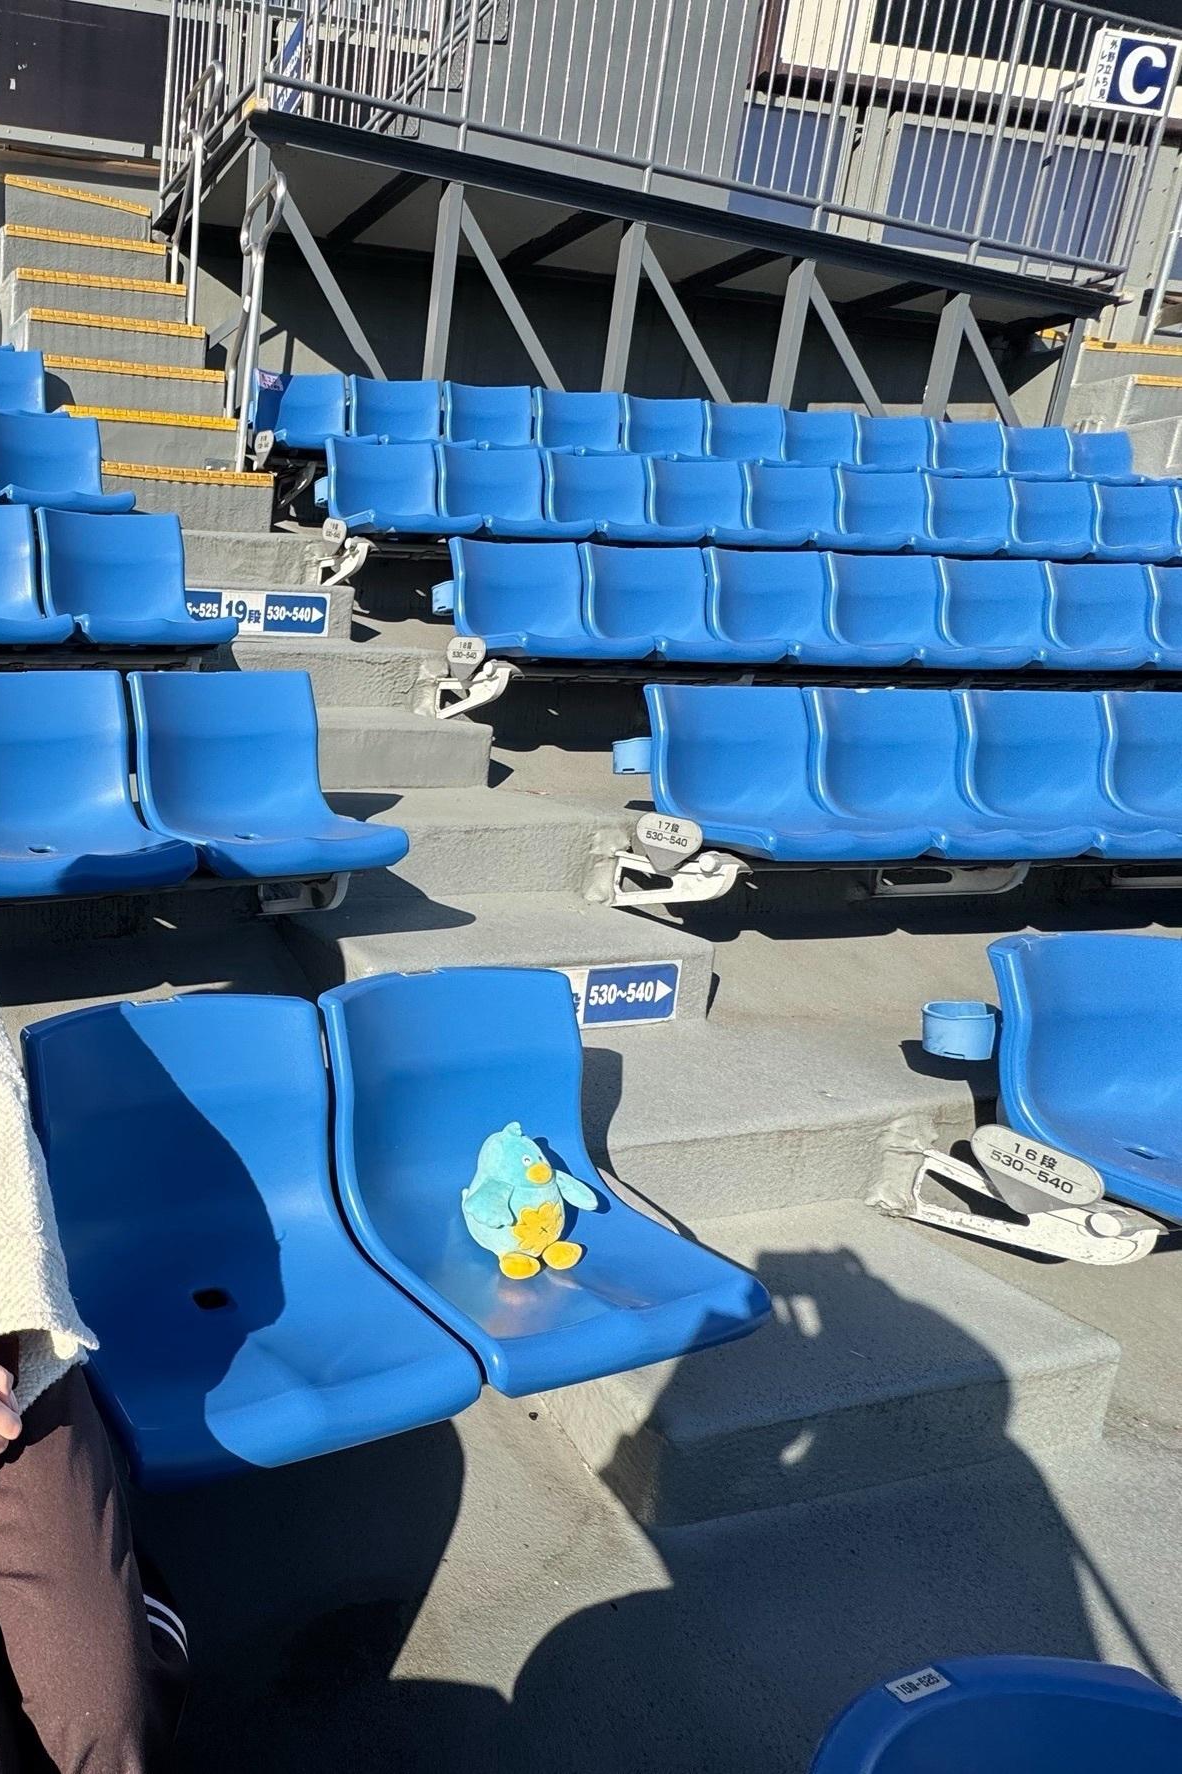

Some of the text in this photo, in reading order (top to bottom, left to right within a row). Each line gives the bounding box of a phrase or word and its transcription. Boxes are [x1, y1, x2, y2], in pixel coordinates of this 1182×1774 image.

[1094, 50, 1108, 87] レフト
[1097, 40, 1118, 99] 外野立ち見
[1118, 45, 1168, 105] C
[225, 600, 262, 624] 19段
[267, 605, 311, 622] 530~540
[645, 830, 688, 847] 530~540
[658, 820, 680, 833] 17段
[588, 981, 655, 1006] 530~540
[1014, 1142, 1058, 1171] 16段
[989, 1149, 1074, 1195] 530~540
